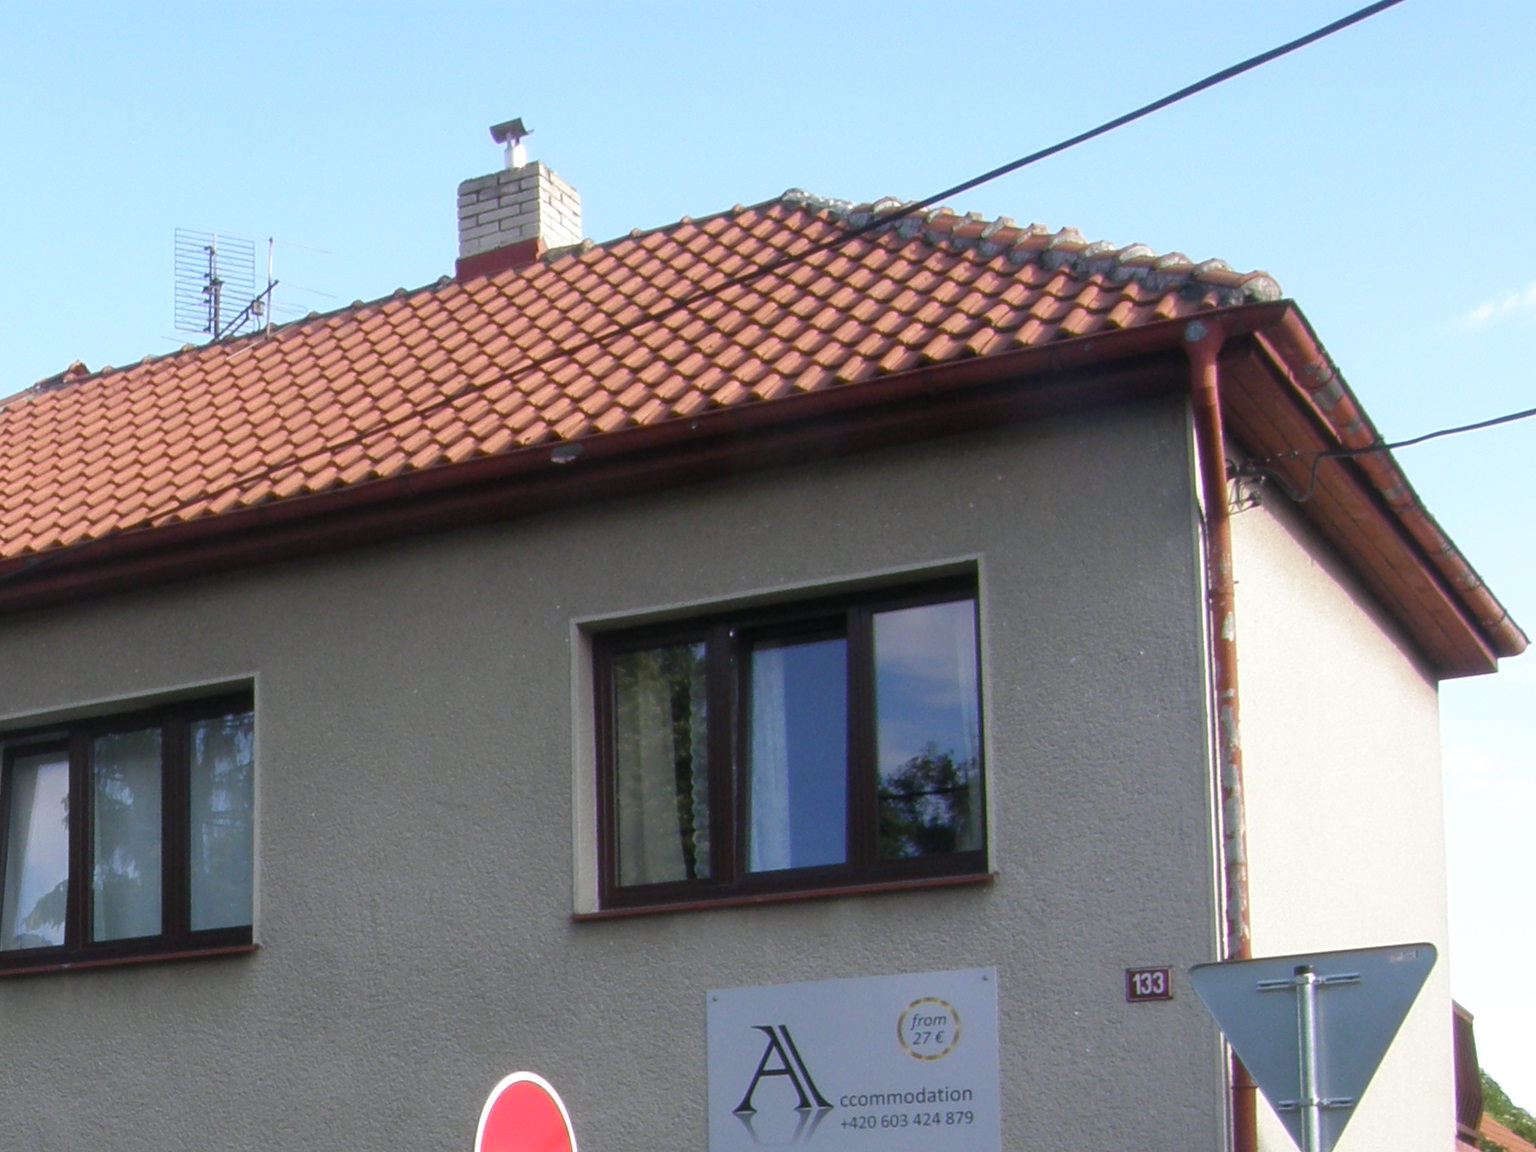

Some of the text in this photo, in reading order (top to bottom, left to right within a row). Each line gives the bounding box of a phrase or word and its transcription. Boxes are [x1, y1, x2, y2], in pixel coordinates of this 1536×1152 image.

[1132, 972, 1164, 995] 133
[910, 1013, 947, 1031] from
[912, 1030, 945, 1045] 27 €
[840, 1110, 974, 1129] +420 603 424 879
